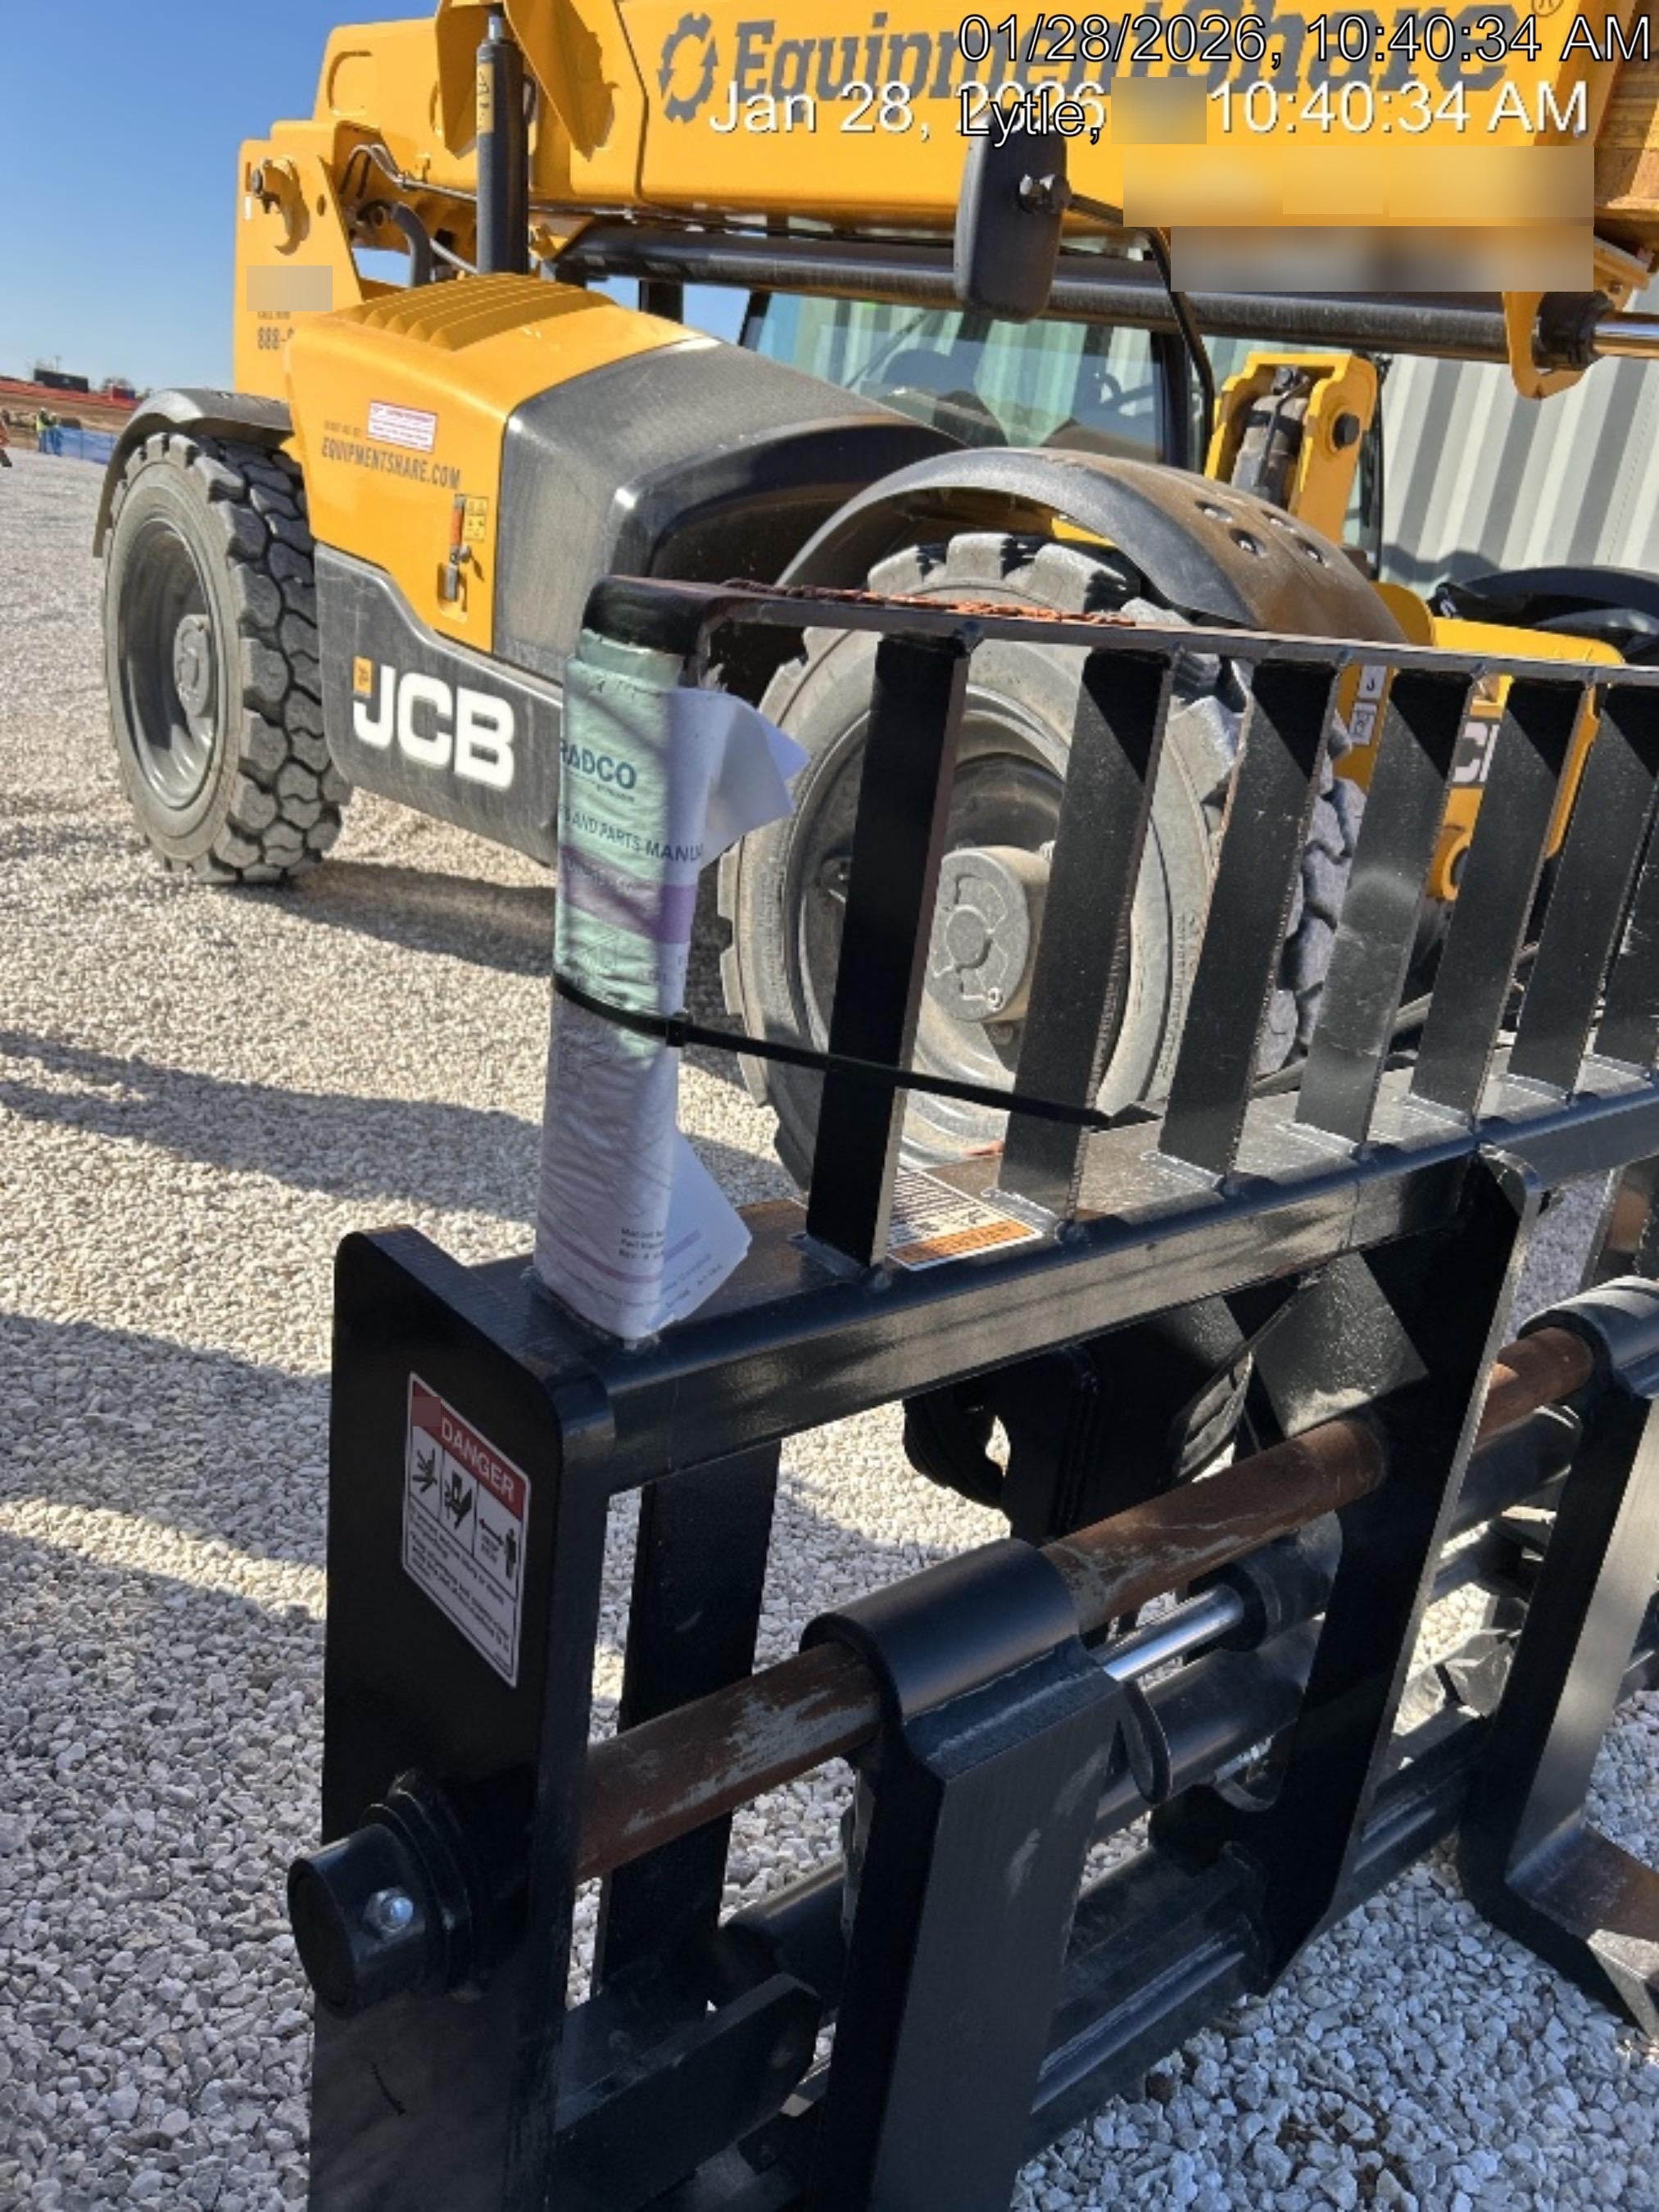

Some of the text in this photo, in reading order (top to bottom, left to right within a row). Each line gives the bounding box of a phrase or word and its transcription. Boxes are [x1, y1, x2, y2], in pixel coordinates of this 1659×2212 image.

[321, 437, 460, 490] EQUIPMENTSHARE.COM
[353, 664, 514, 791] JCB
[600, 823, 641, 851] PARTS
[442, 1417, 514, 1503] DANGER
